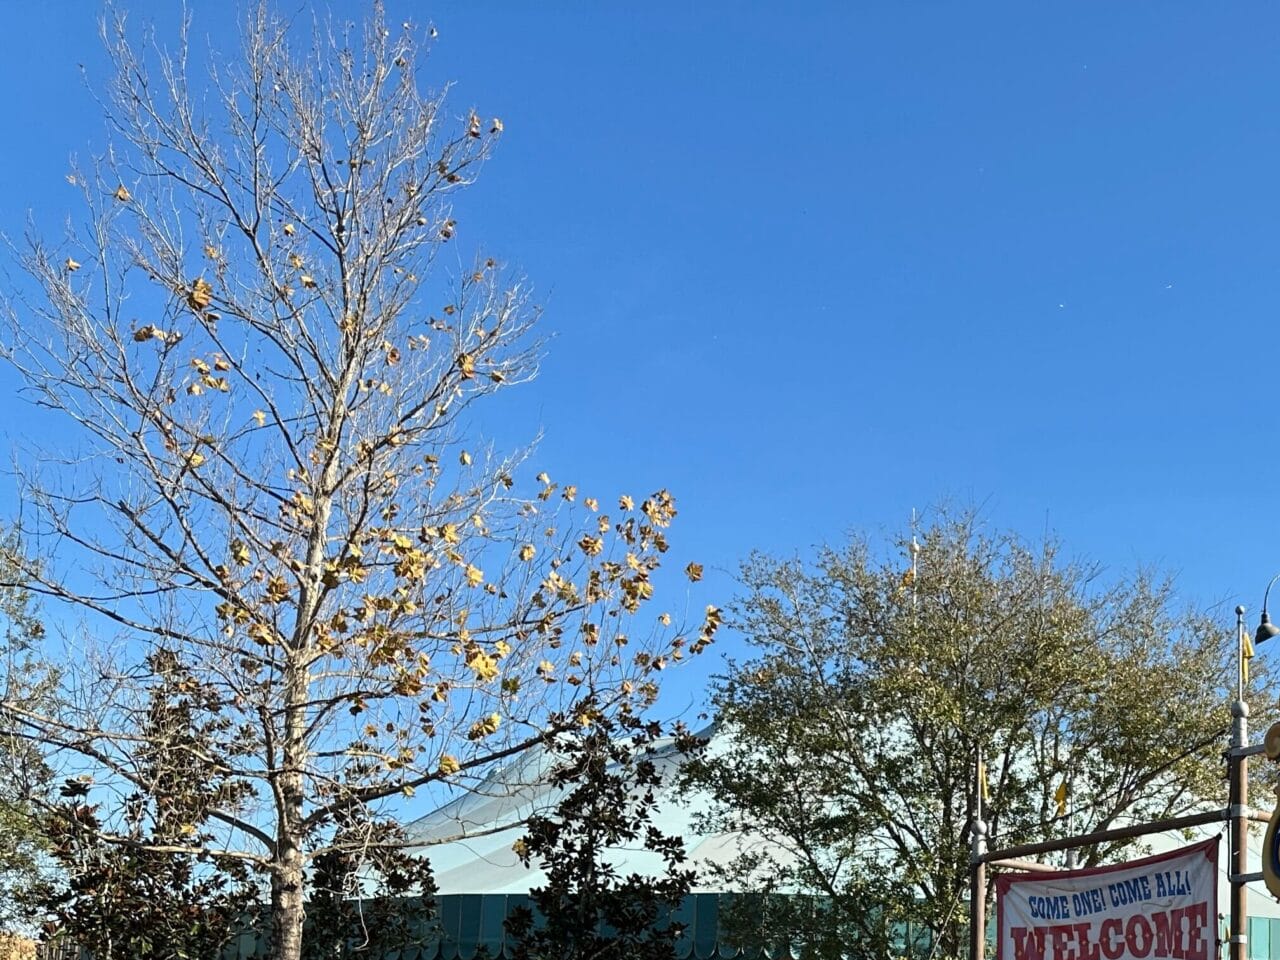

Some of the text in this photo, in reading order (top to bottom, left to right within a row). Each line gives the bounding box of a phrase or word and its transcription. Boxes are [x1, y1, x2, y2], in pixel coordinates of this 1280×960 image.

[1029, 870, 1192, 920] COME ONE! COME ALL!
